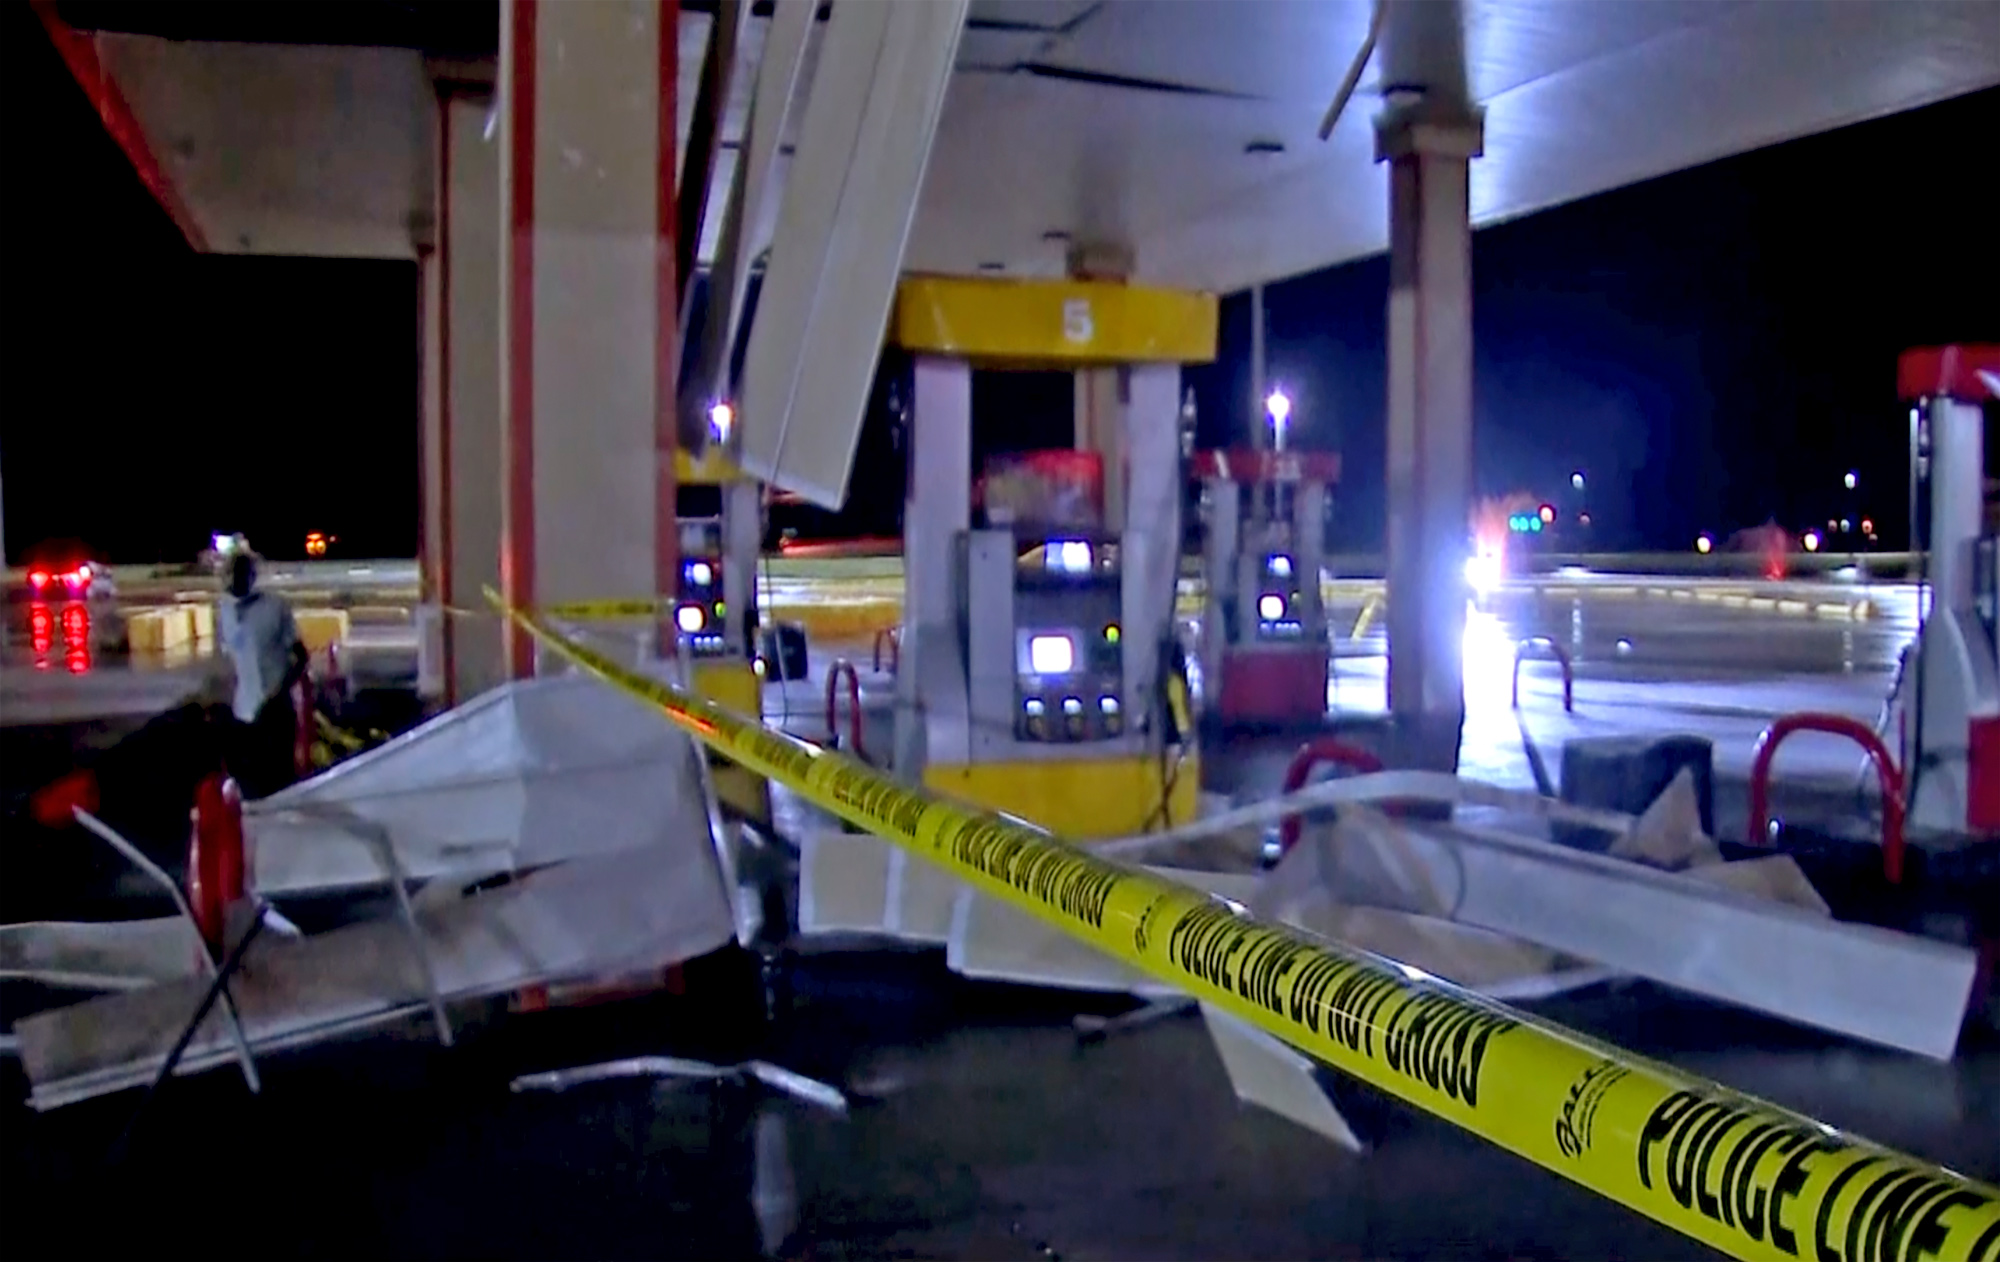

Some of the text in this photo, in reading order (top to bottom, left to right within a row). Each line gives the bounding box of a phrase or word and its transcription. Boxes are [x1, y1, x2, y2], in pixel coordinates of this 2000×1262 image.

[1063, 298, 1093, 342] 5
[1169, 904, 1260, 991] POLICE
[1239, 931, 1319, 1015] LINE
[1291, 953, 1356, 1034] DO
[1329, 965, 1408, 1059] NOT
[1385, 990, 1522, 1107] CROSS
[1638, 1090, 1845, 1257] POLICE
[1815, 1156, 1985, 1262] LINE
